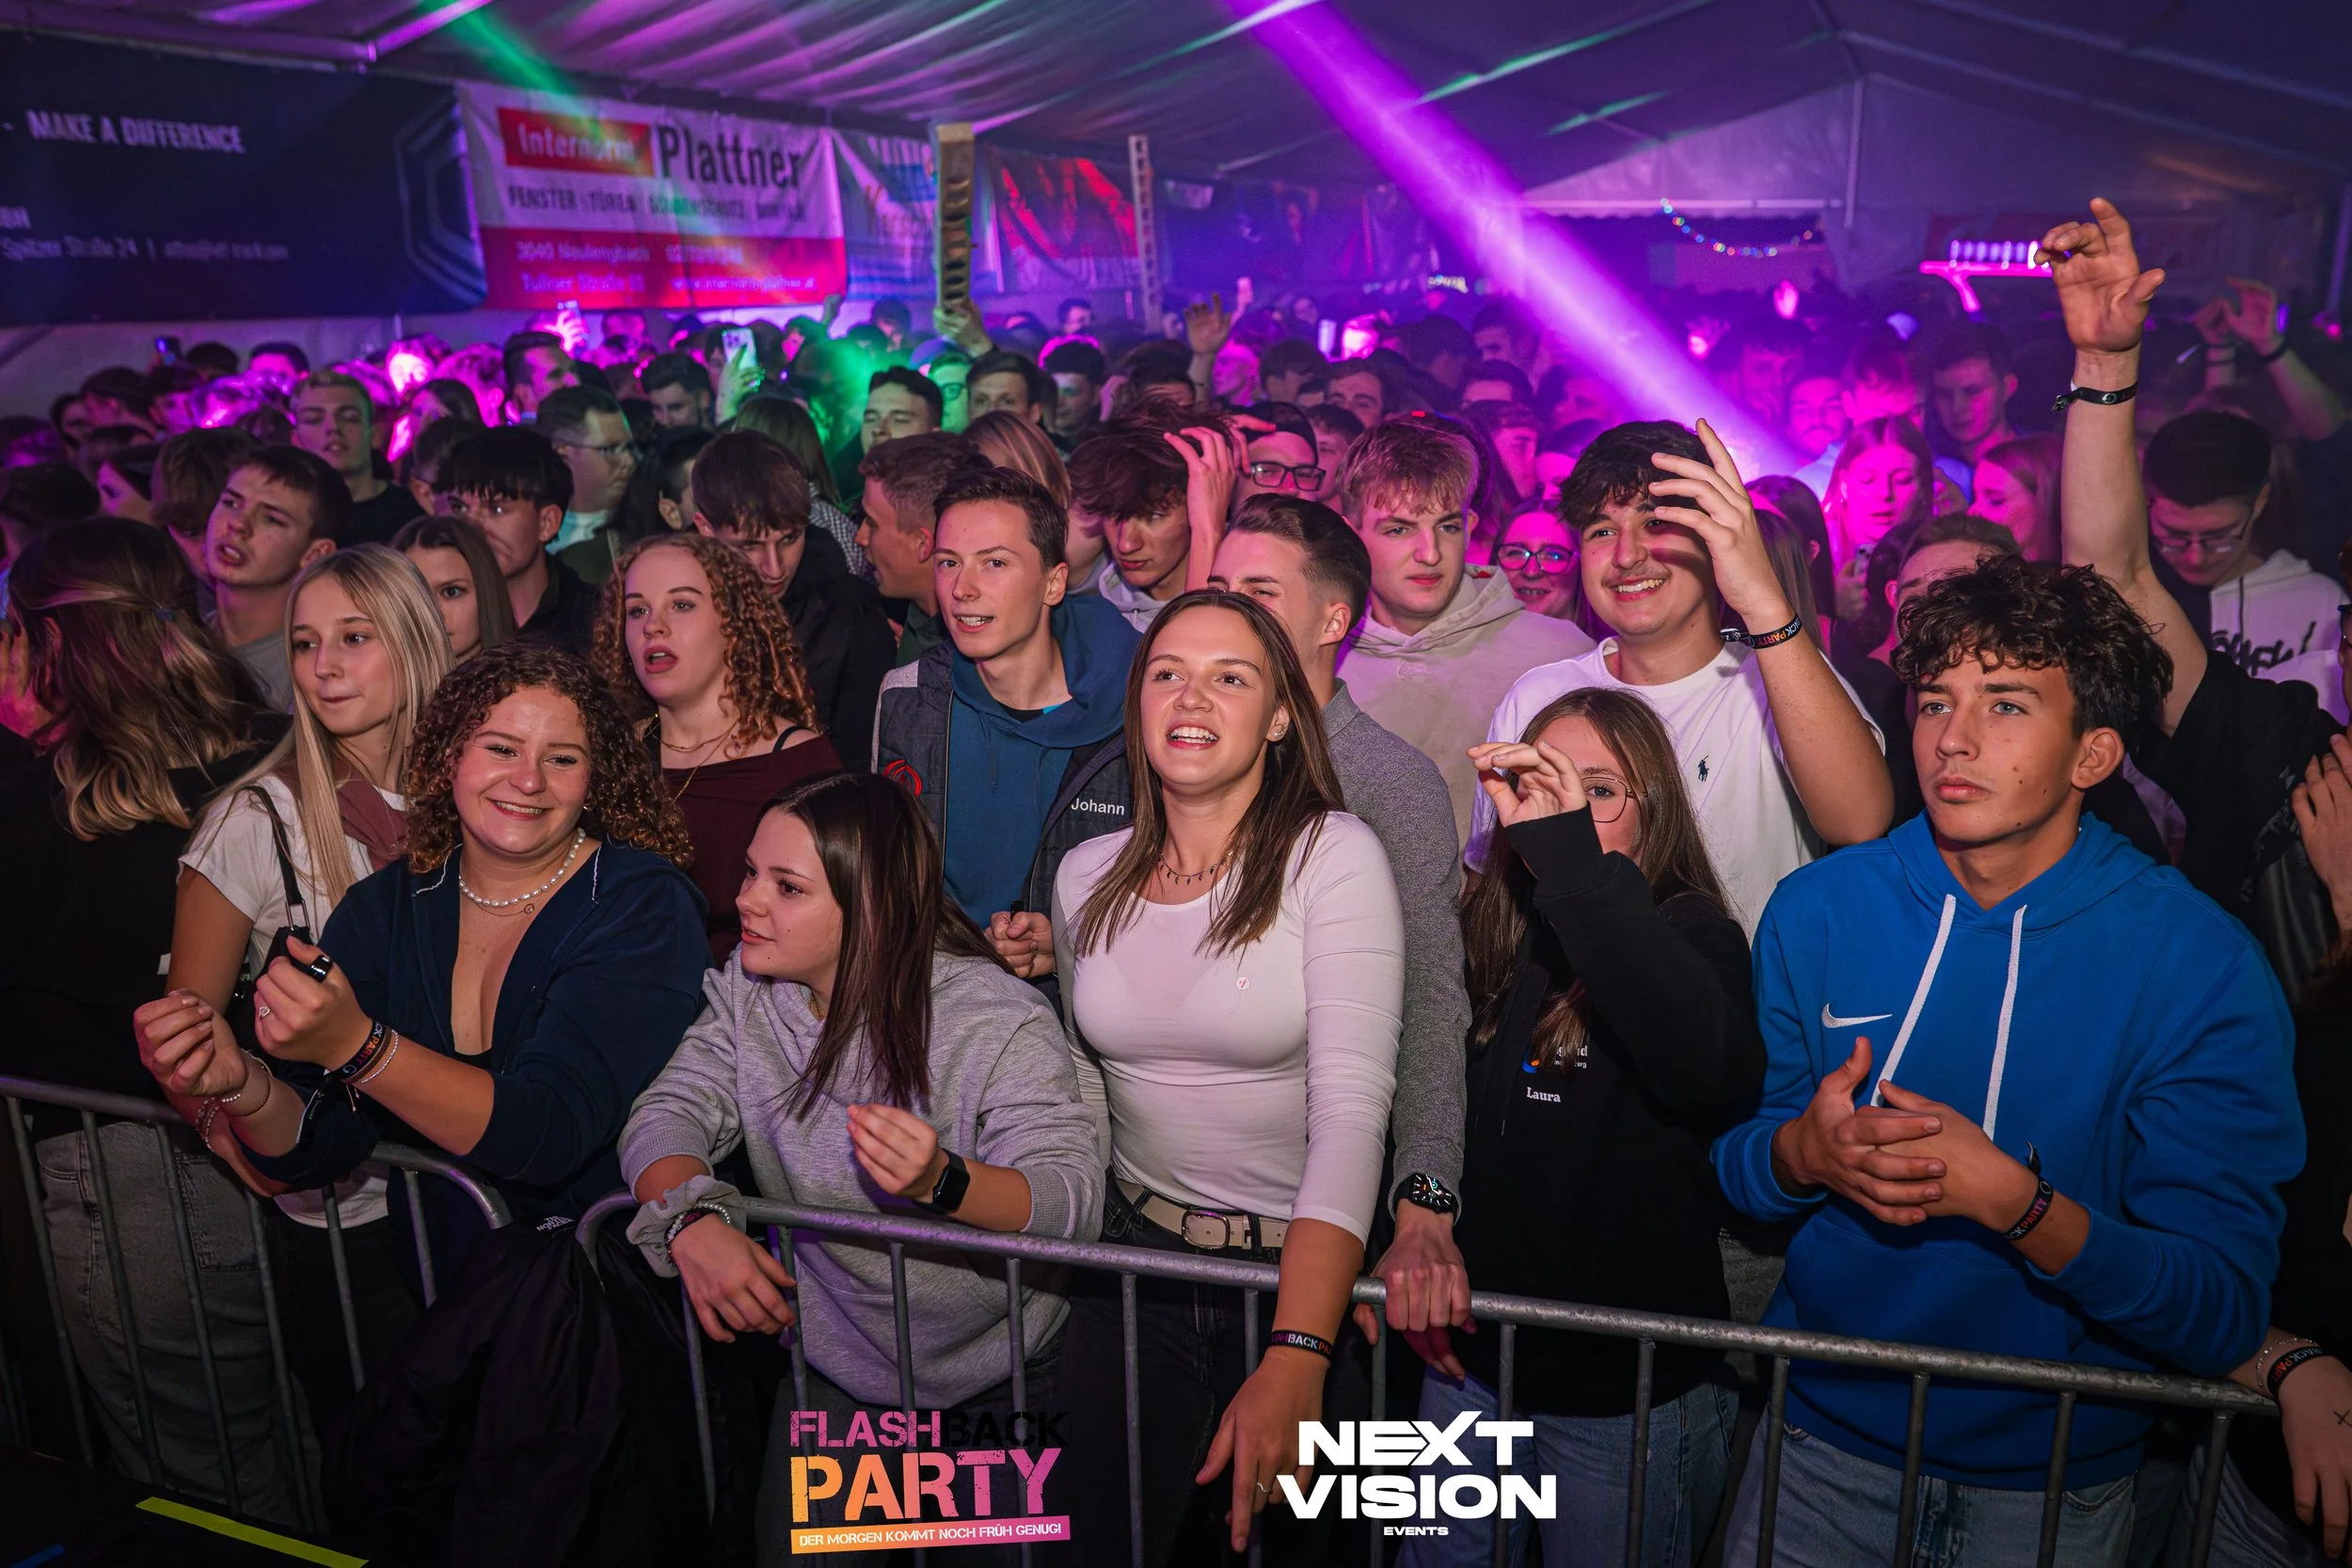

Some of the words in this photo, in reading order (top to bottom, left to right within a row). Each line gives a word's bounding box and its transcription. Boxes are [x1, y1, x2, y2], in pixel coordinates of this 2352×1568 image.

[25, 109, 96, 143] MAKE
[100, 115, 119, 144] A
[120, 116, 246, 154] DIFFERENCE
[658, 126, 800, 188] Plattner
[1071, 798, 1125, 816] Johann
[1526, 1086, 1562, 1102] Laura
[2020, 1197, 2047, 1229] PARTY
